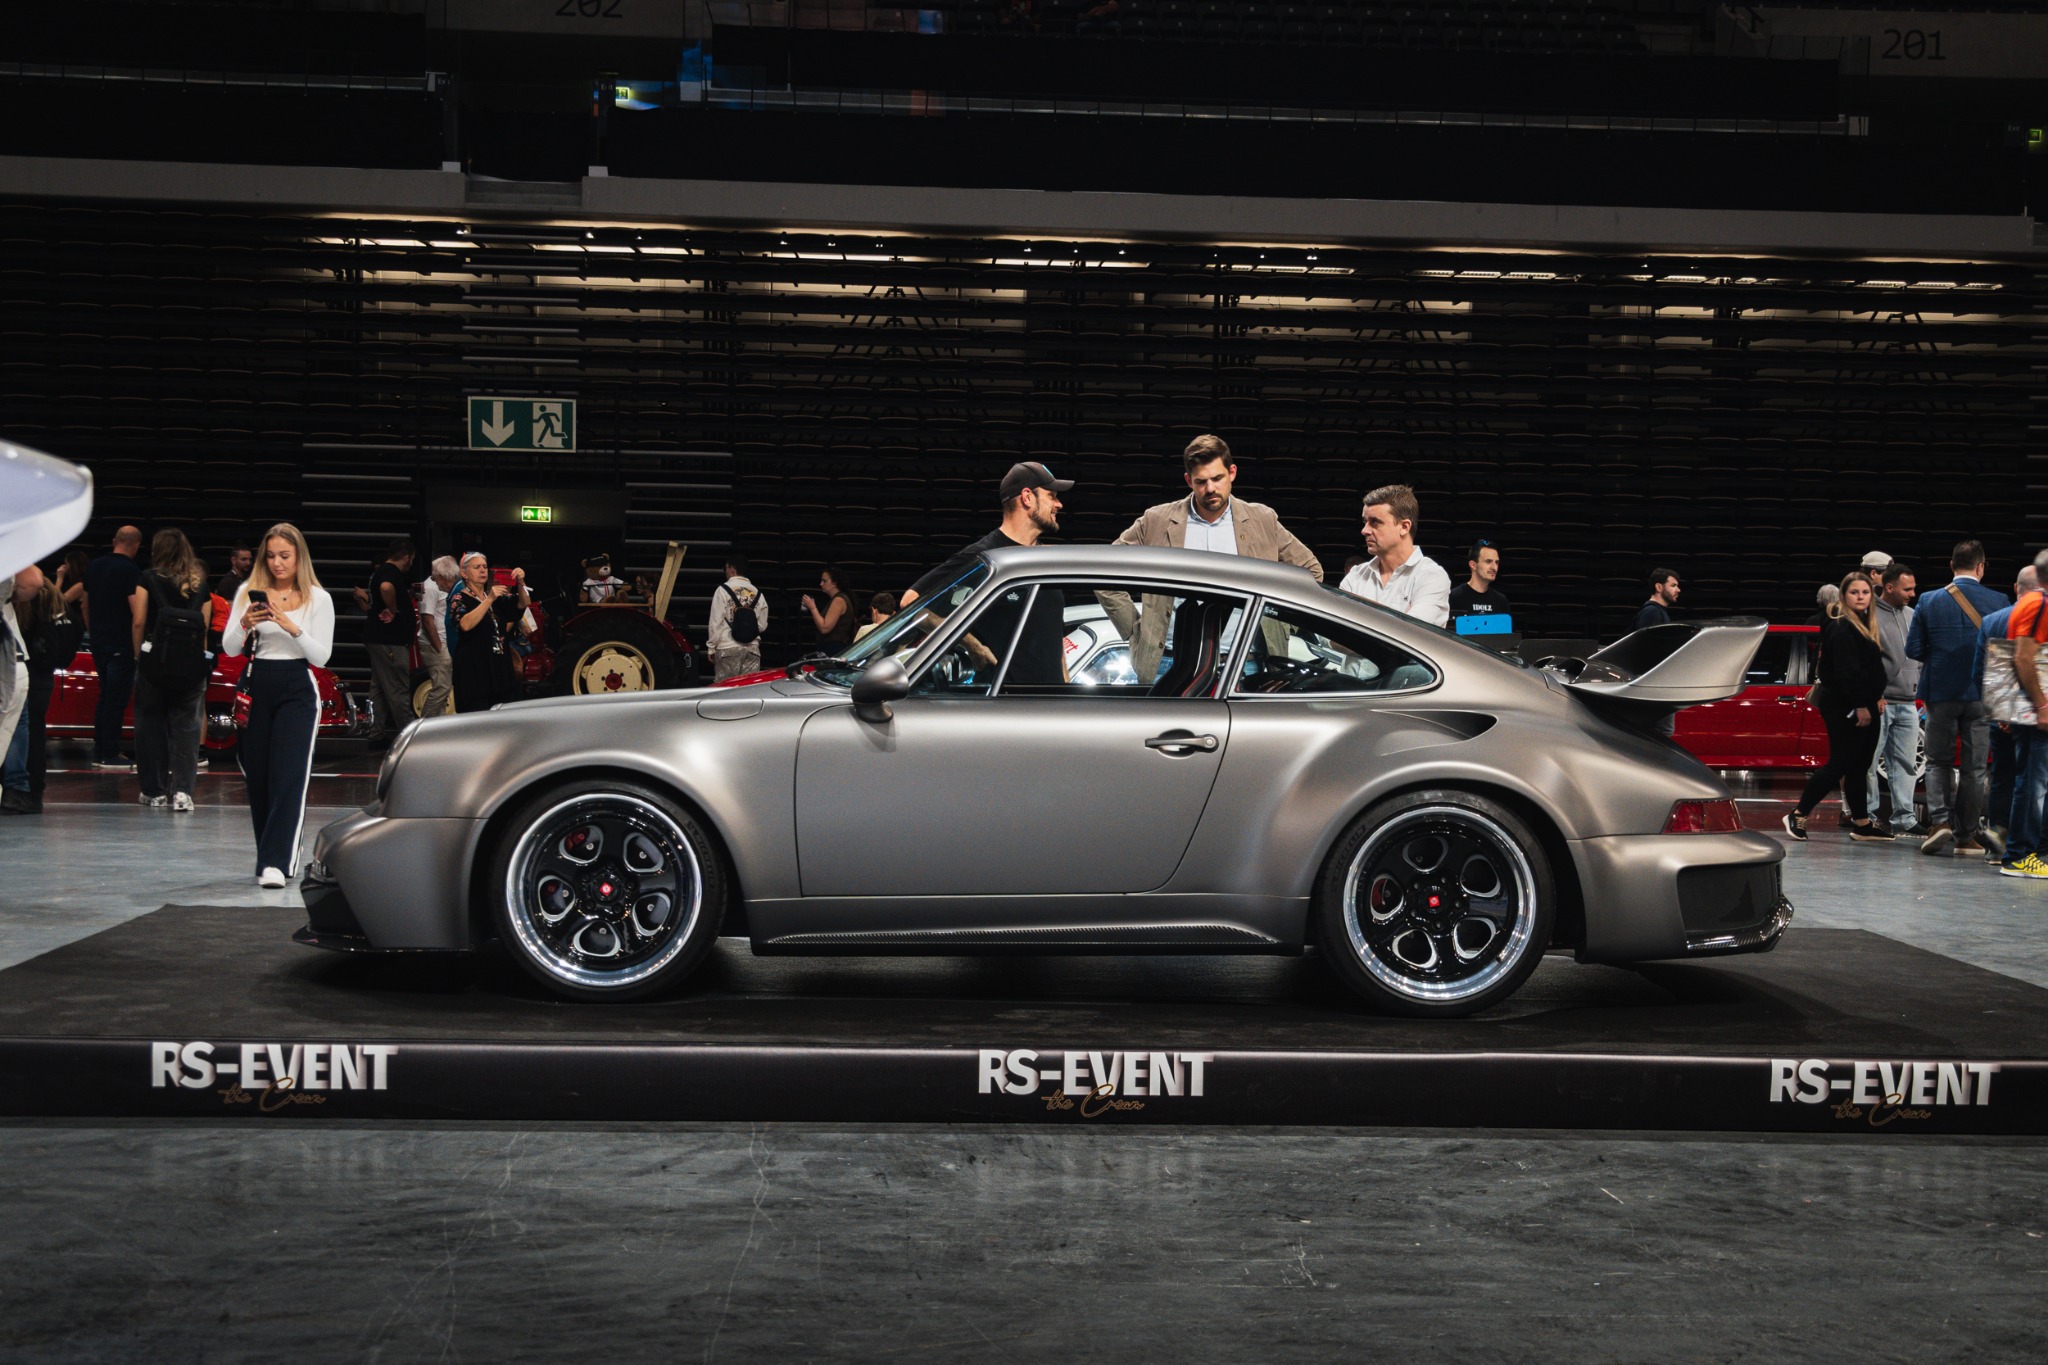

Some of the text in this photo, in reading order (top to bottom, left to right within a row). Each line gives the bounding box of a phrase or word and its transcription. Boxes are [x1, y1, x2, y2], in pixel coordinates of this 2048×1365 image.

[556, 0, 623, 18] 202
[1881, 28, 1947, 60] 201
[152, 1041, 398, 1090] RS-EVENT
[978, 1048, 1214, 1097] RS-EVENT
[218, 1082, 253, 1105] the
[1769, 1058, 2001, 1106] RS-EVENT
[1041, 1089, 1074, 1111] the
[1830, 1098, 1863, 1119] the
